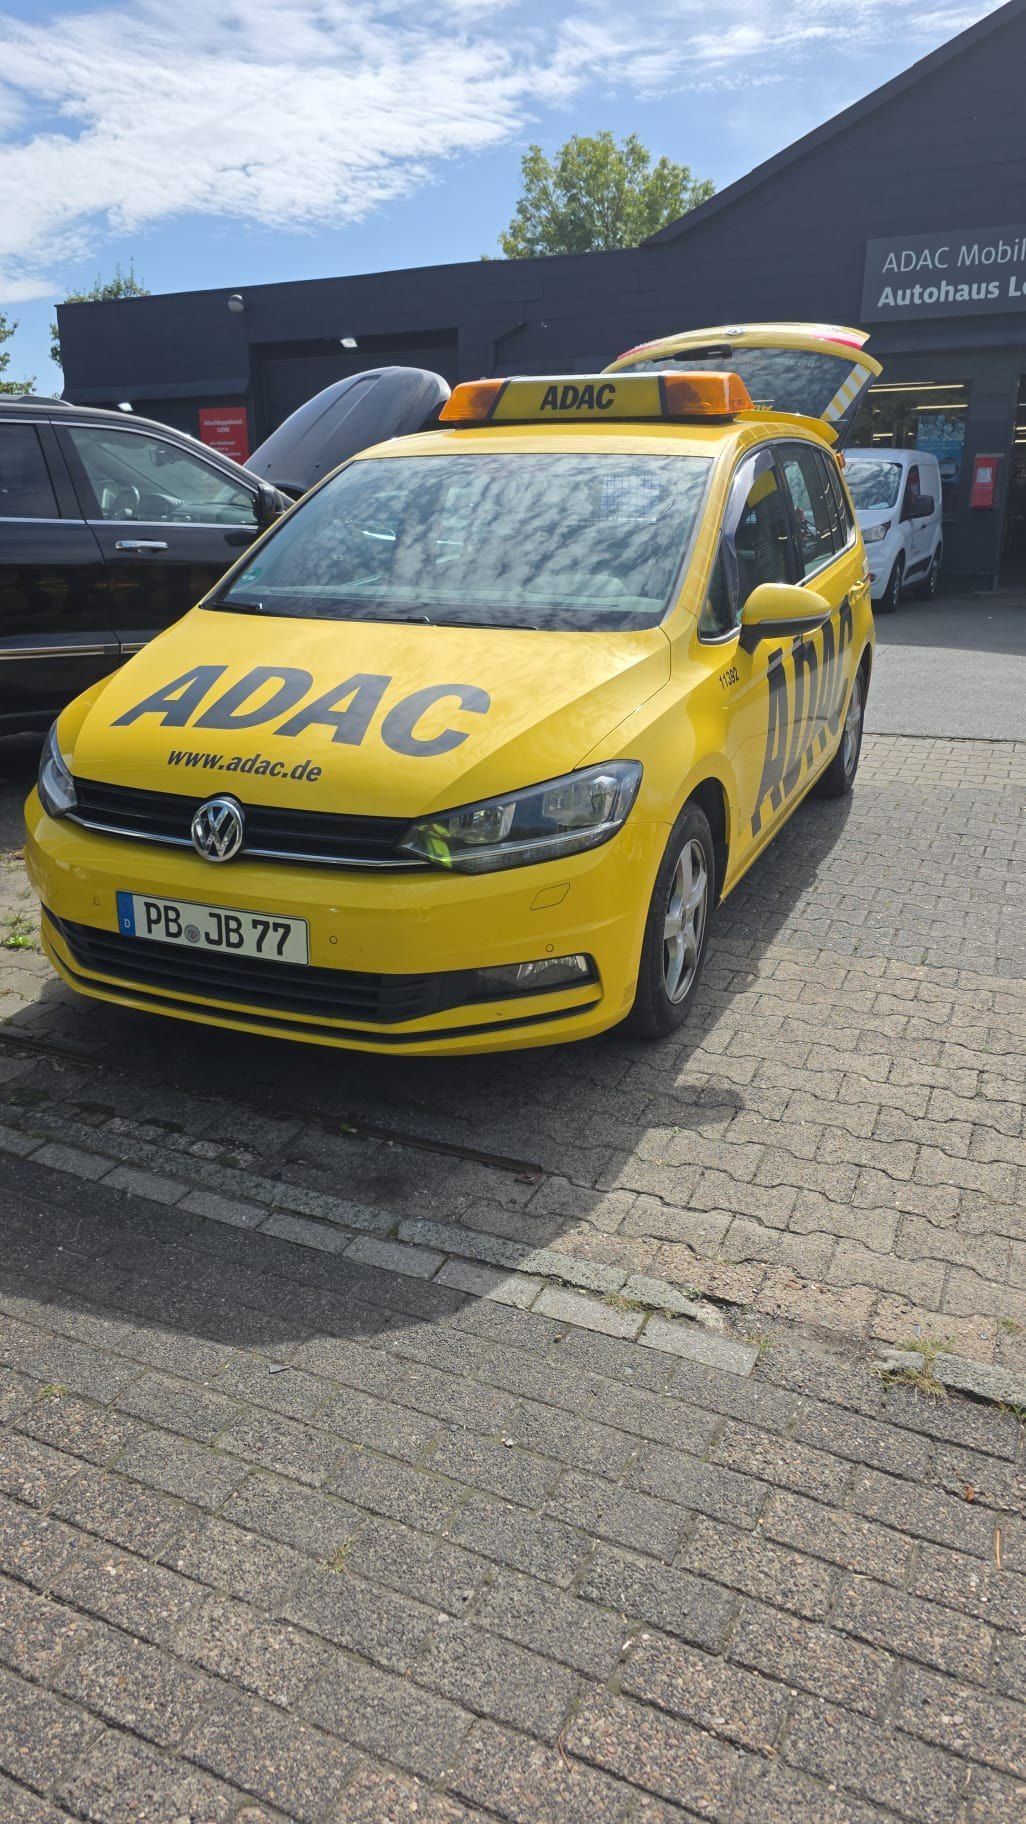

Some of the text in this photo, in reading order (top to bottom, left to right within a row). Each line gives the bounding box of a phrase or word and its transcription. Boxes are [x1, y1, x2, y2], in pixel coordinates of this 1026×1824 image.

[882, 238, 1026, 273] ADAC Mobil
[877, 275, 1026, 307] Autohaus L
[539, 383, 616, 411] ADAC
[110, 665, 491, 757] ADAC
[166, 749, 323, 783] www.adac.de
[143, 901, 183, 938] PB
